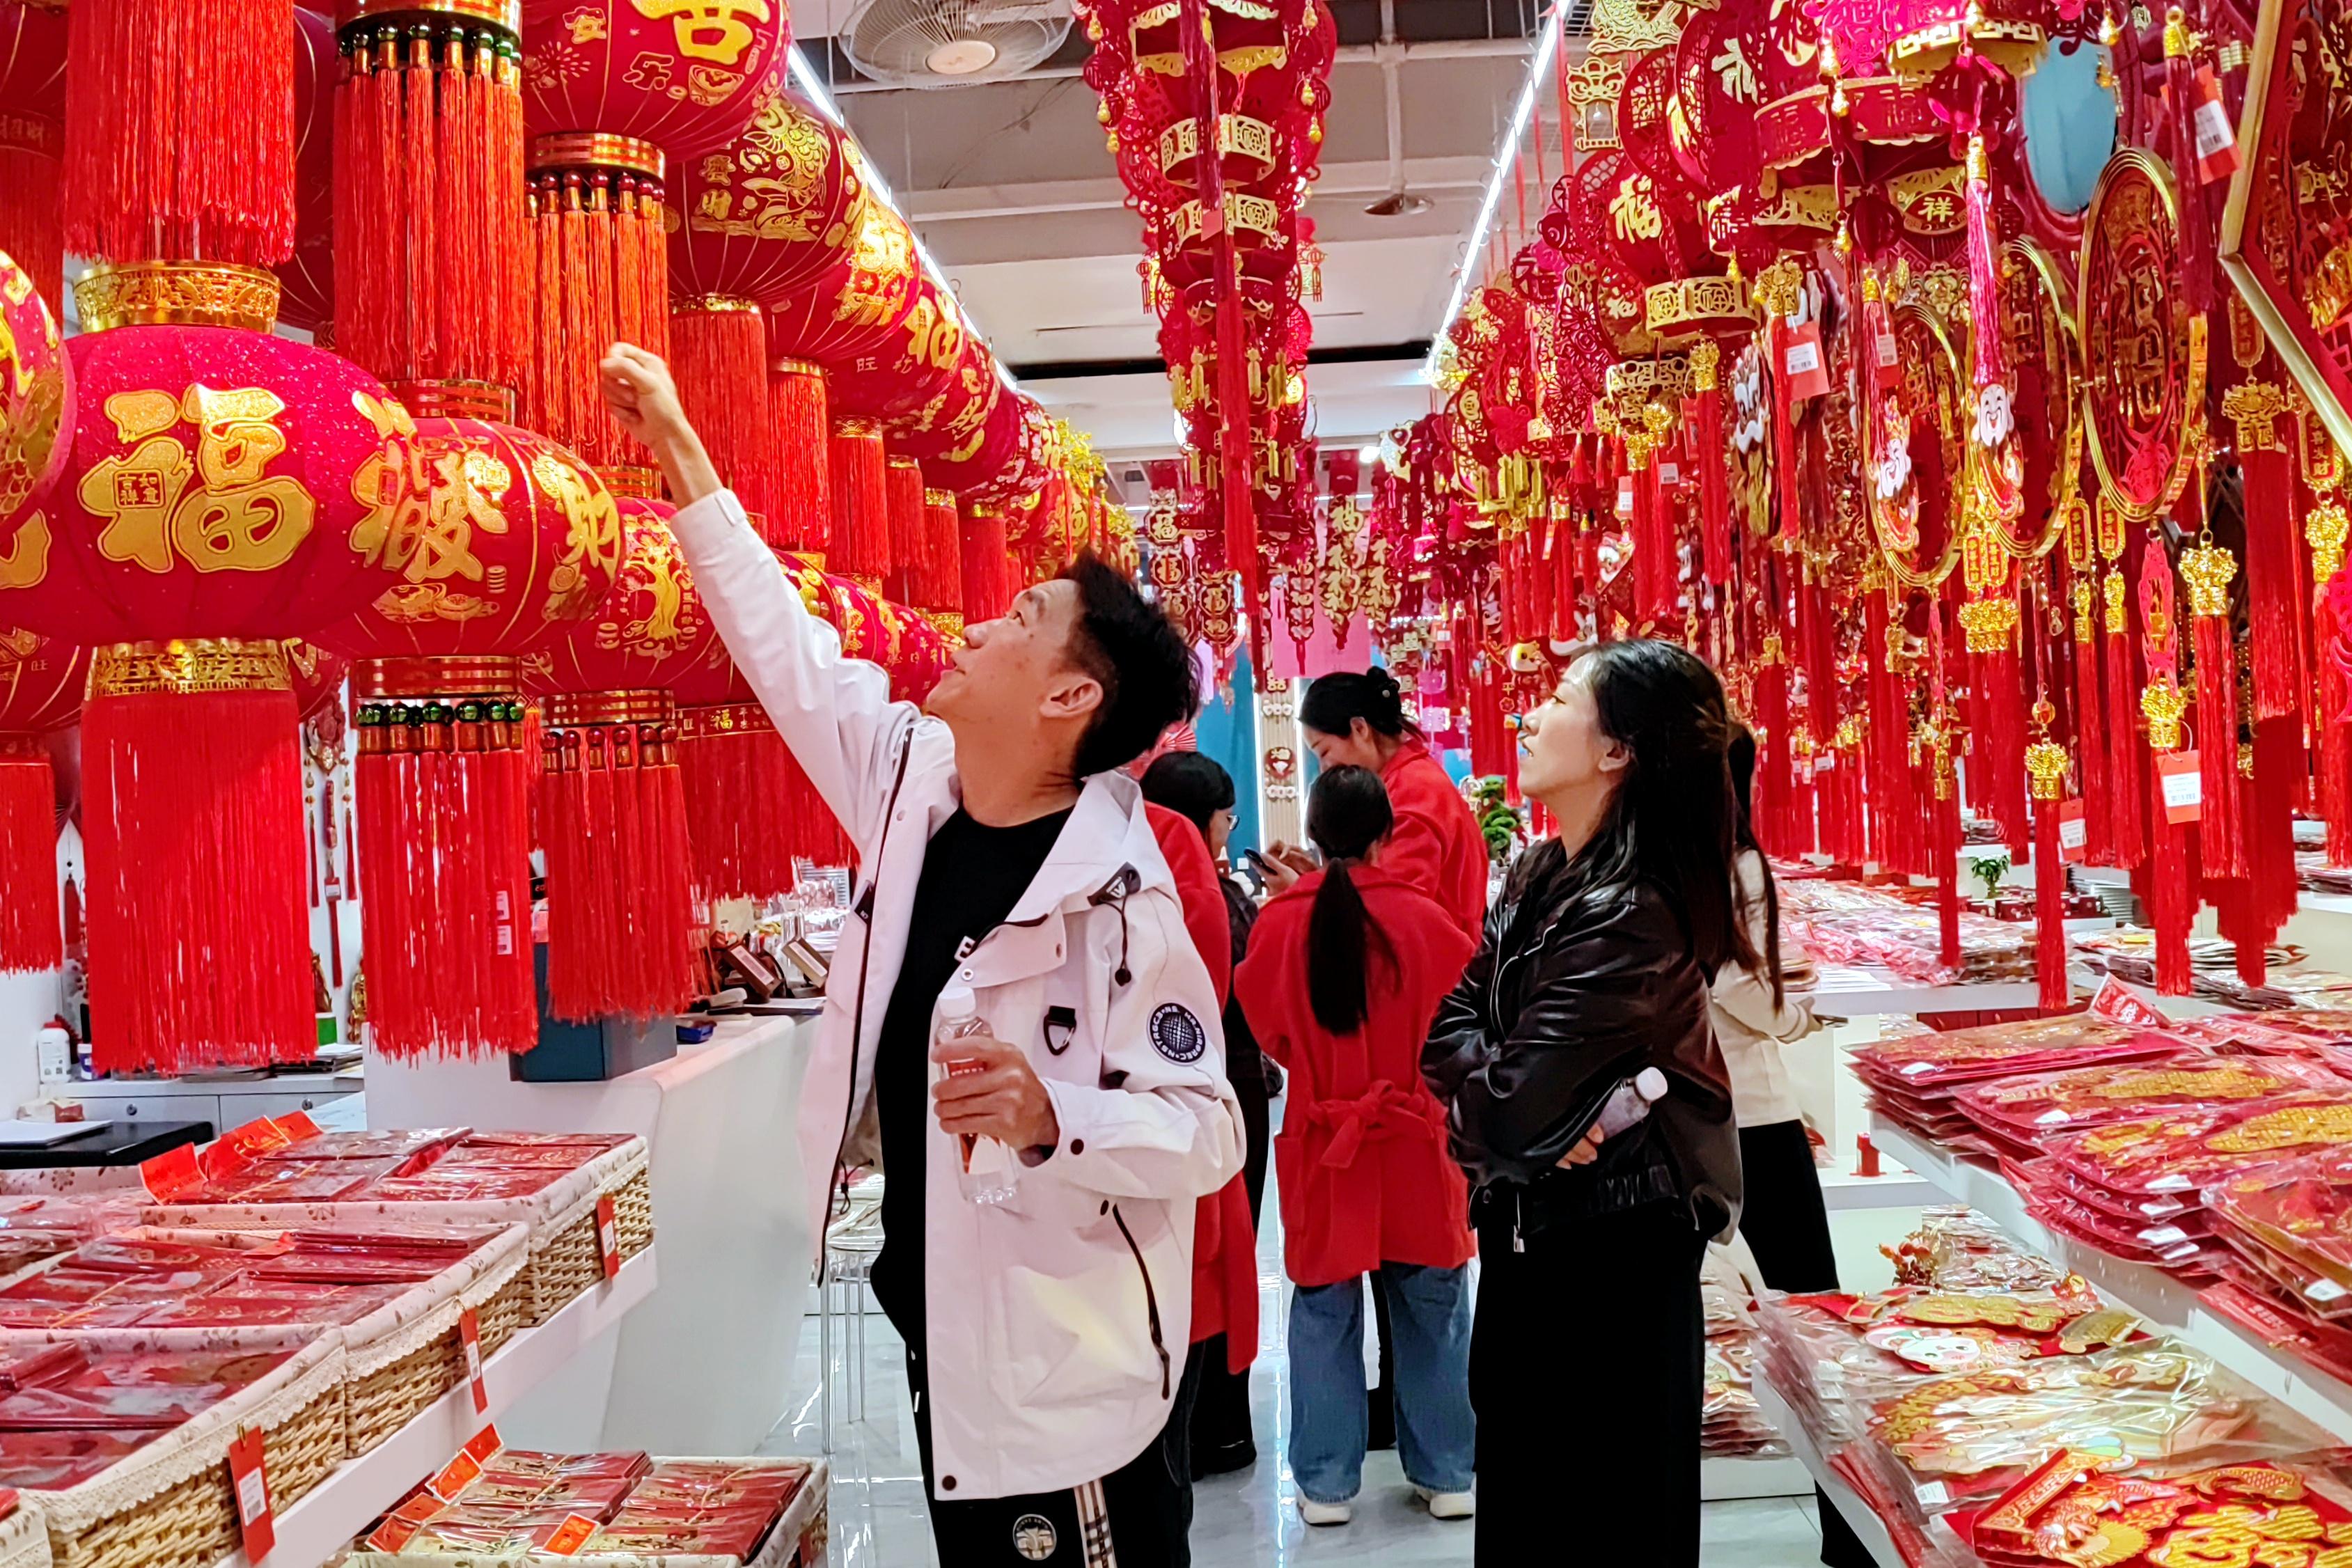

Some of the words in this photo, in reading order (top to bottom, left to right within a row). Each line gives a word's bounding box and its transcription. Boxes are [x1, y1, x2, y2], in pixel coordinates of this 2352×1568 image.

[1610, 173, 1663, 244] 福
[1918, 196, 1954, 223] 祥
[856, 357, 878, 373] 旺
[78, 383, 316, 573] 福
[1152, 512, 1178, 540] 福
[709, 708, 733, 730] 福
